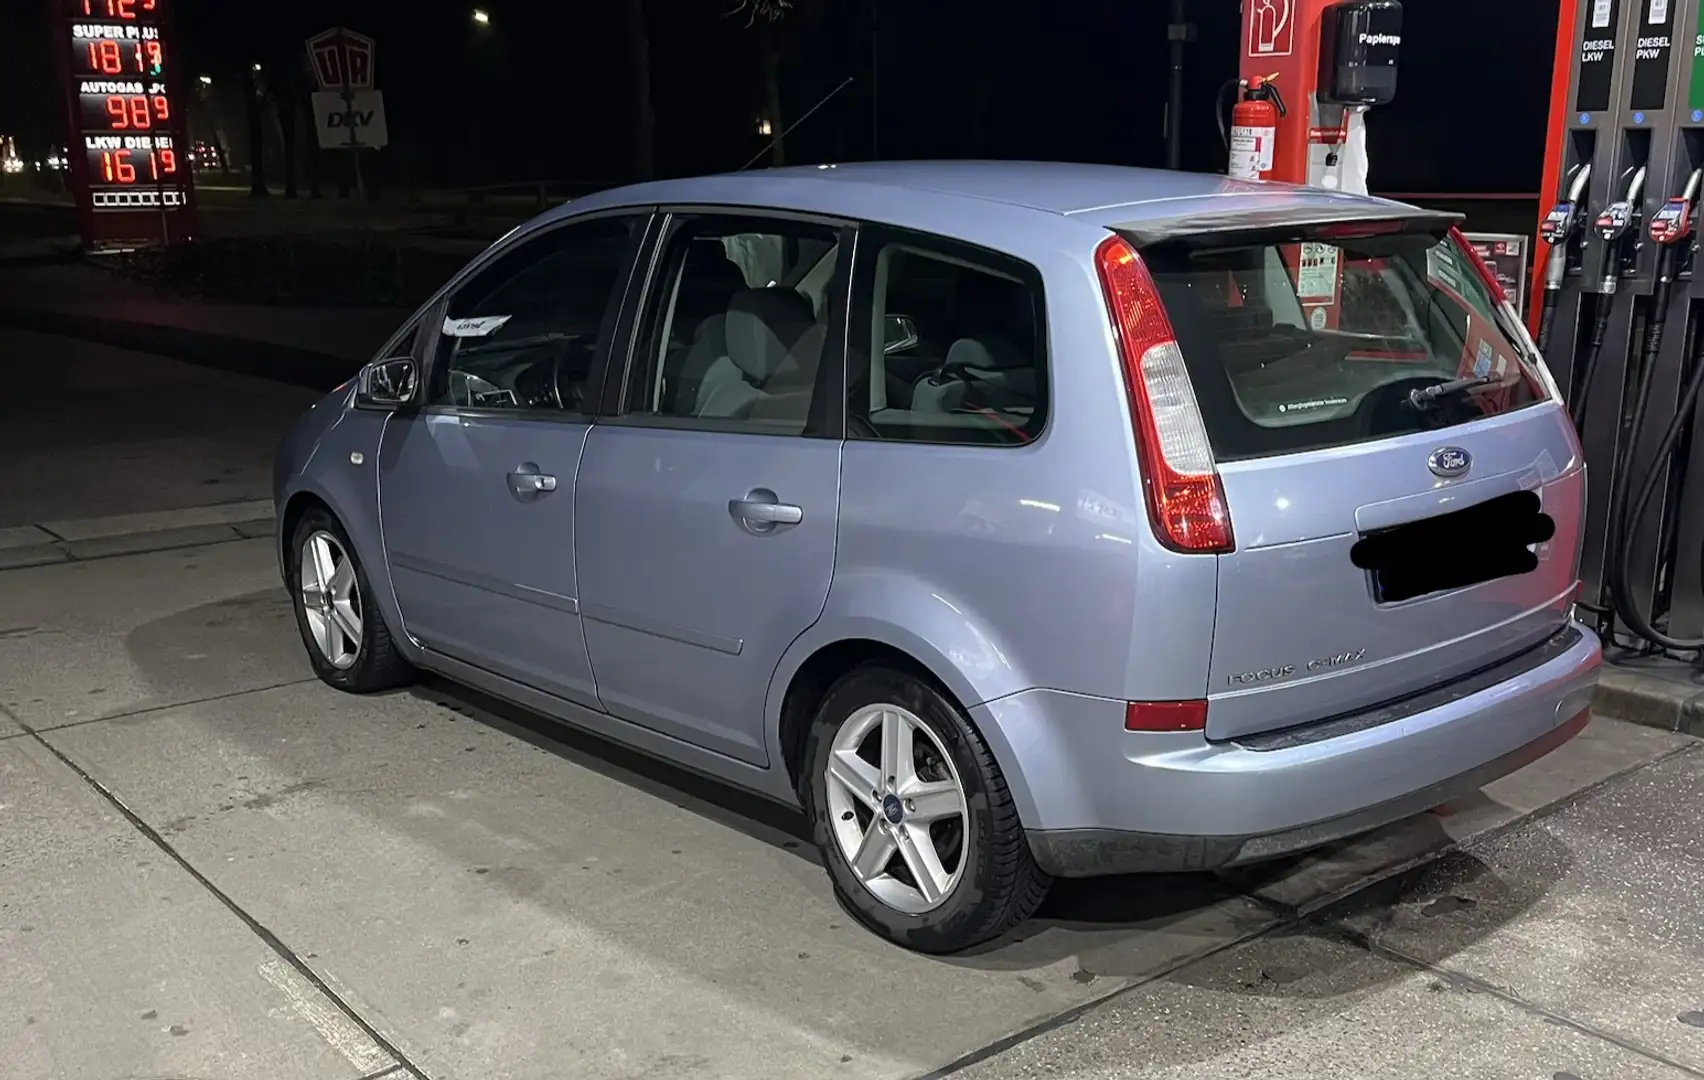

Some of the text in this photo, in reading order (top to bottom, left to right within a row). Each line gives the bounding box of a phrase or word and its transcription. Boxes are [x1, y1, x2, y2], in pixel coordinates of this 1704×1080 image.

[73, 25, 124, 38] SUPER
[1583, 40, 1614, 51] DIESEL
[1638, 37, 1670, 48] DIESEL
[1582, 52, 1604, 62] LKW
[1636, 49, 1660, 59] PKW
[80, 81, 144, 94] AUTOGAS
[327, 110, 374, 128] DKV
[85, 136, 121, 149] LKW
[1443, 452, 1465, 469] Ford
[1227, 648, 1366, 686] FOCUS C-MAX
